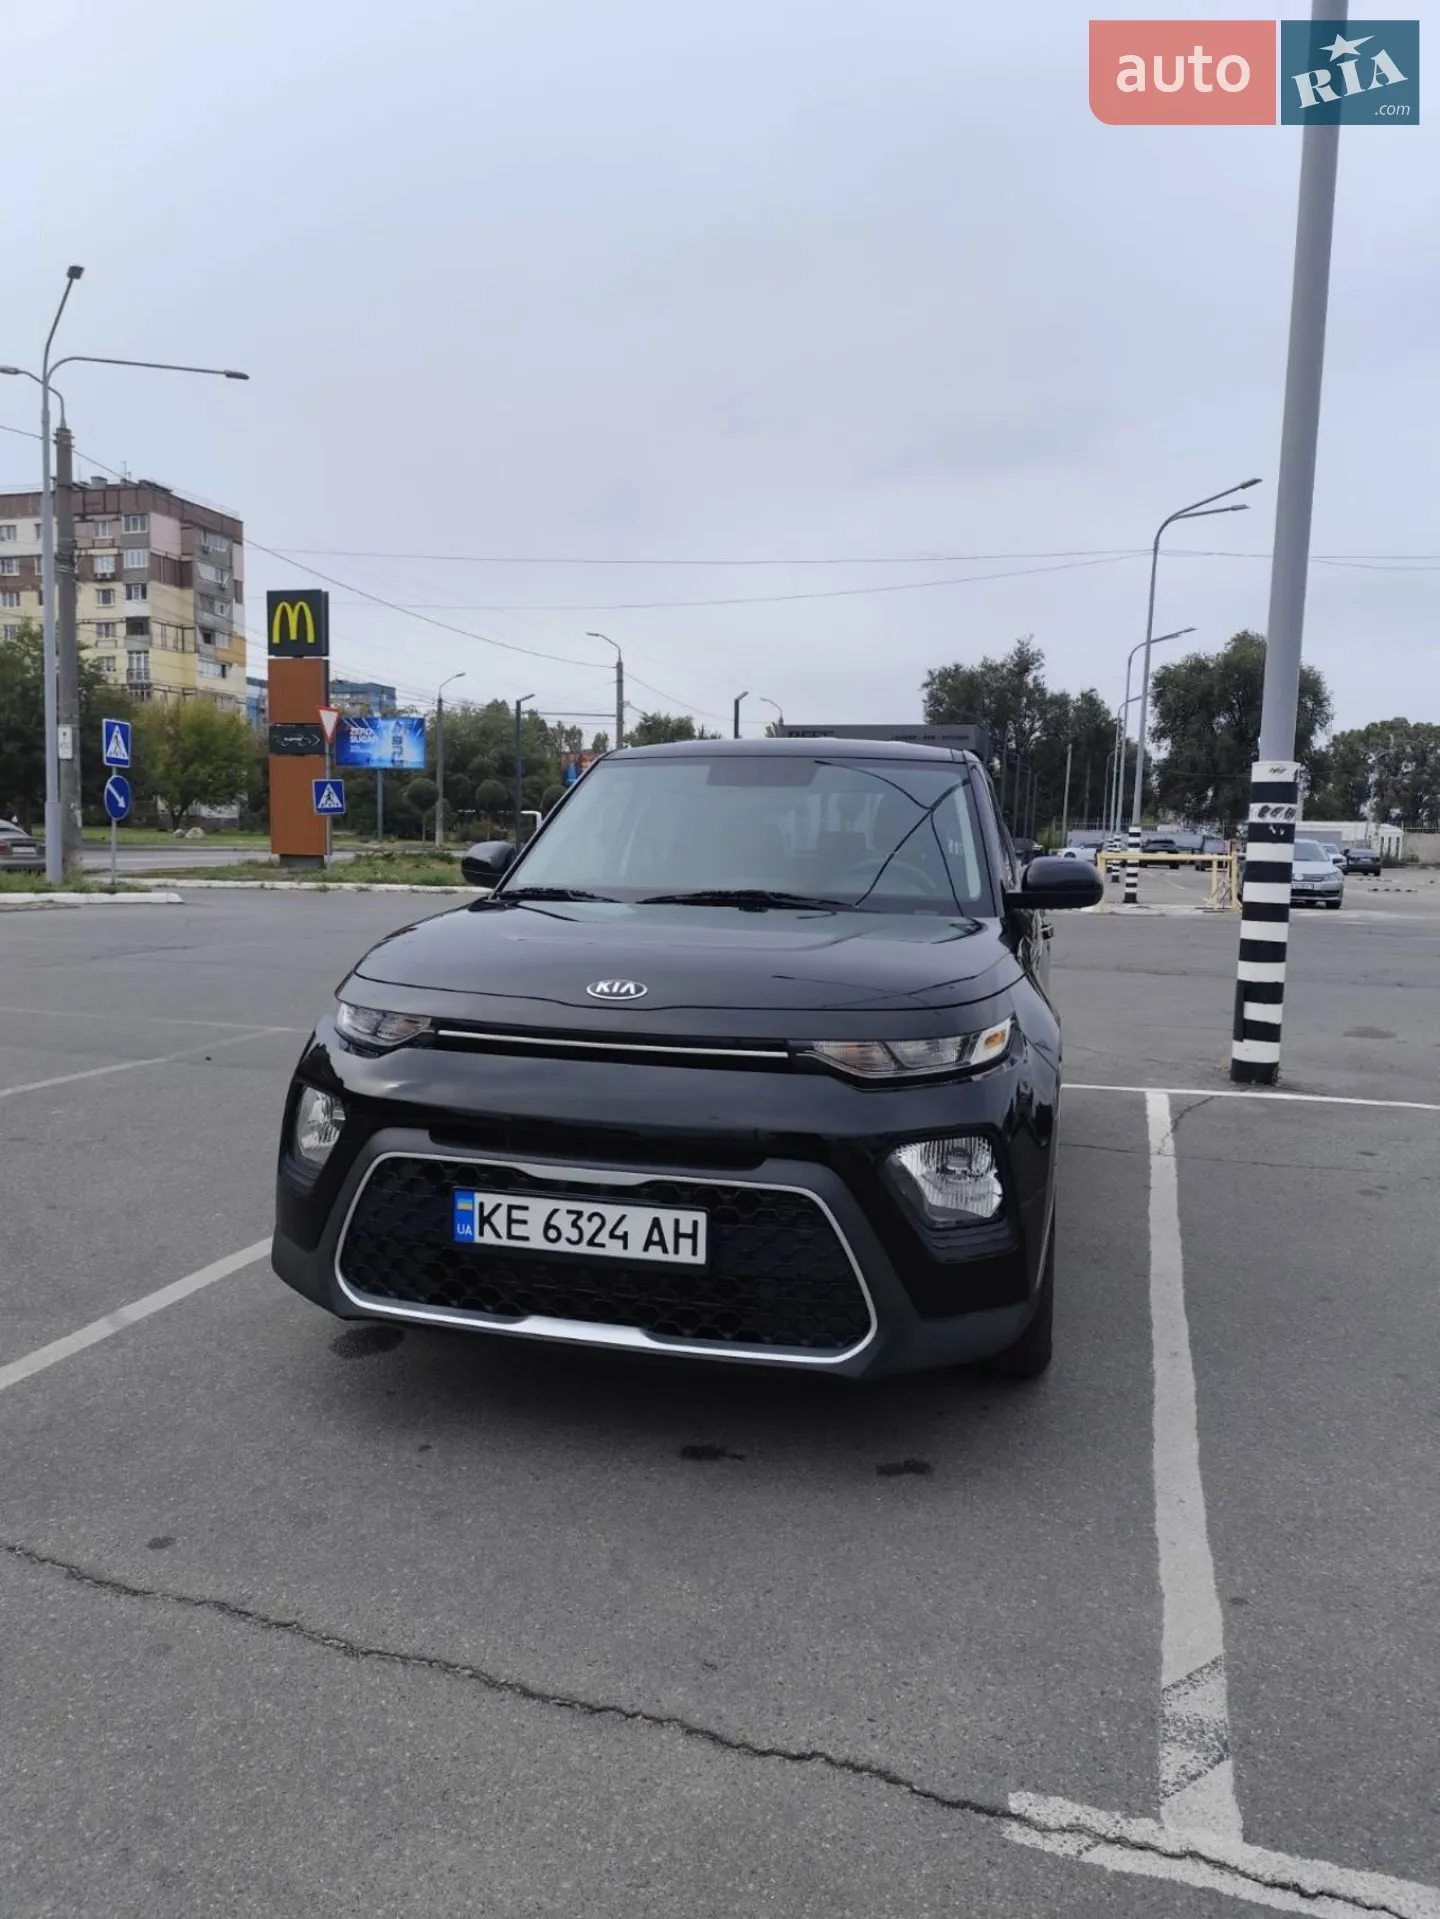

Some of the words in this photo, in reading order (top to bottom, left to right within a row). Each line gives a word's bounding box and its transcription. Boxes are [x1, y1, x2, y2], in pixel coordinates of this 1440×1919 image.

[595, 981, 636, 995] KIA
[456, 1223, 473, 1236] UA
[477, 1201, 530, 1242] KE
[542, 1208, 629, 1250] 6324
[642, 1216, 699, 1257] AH
